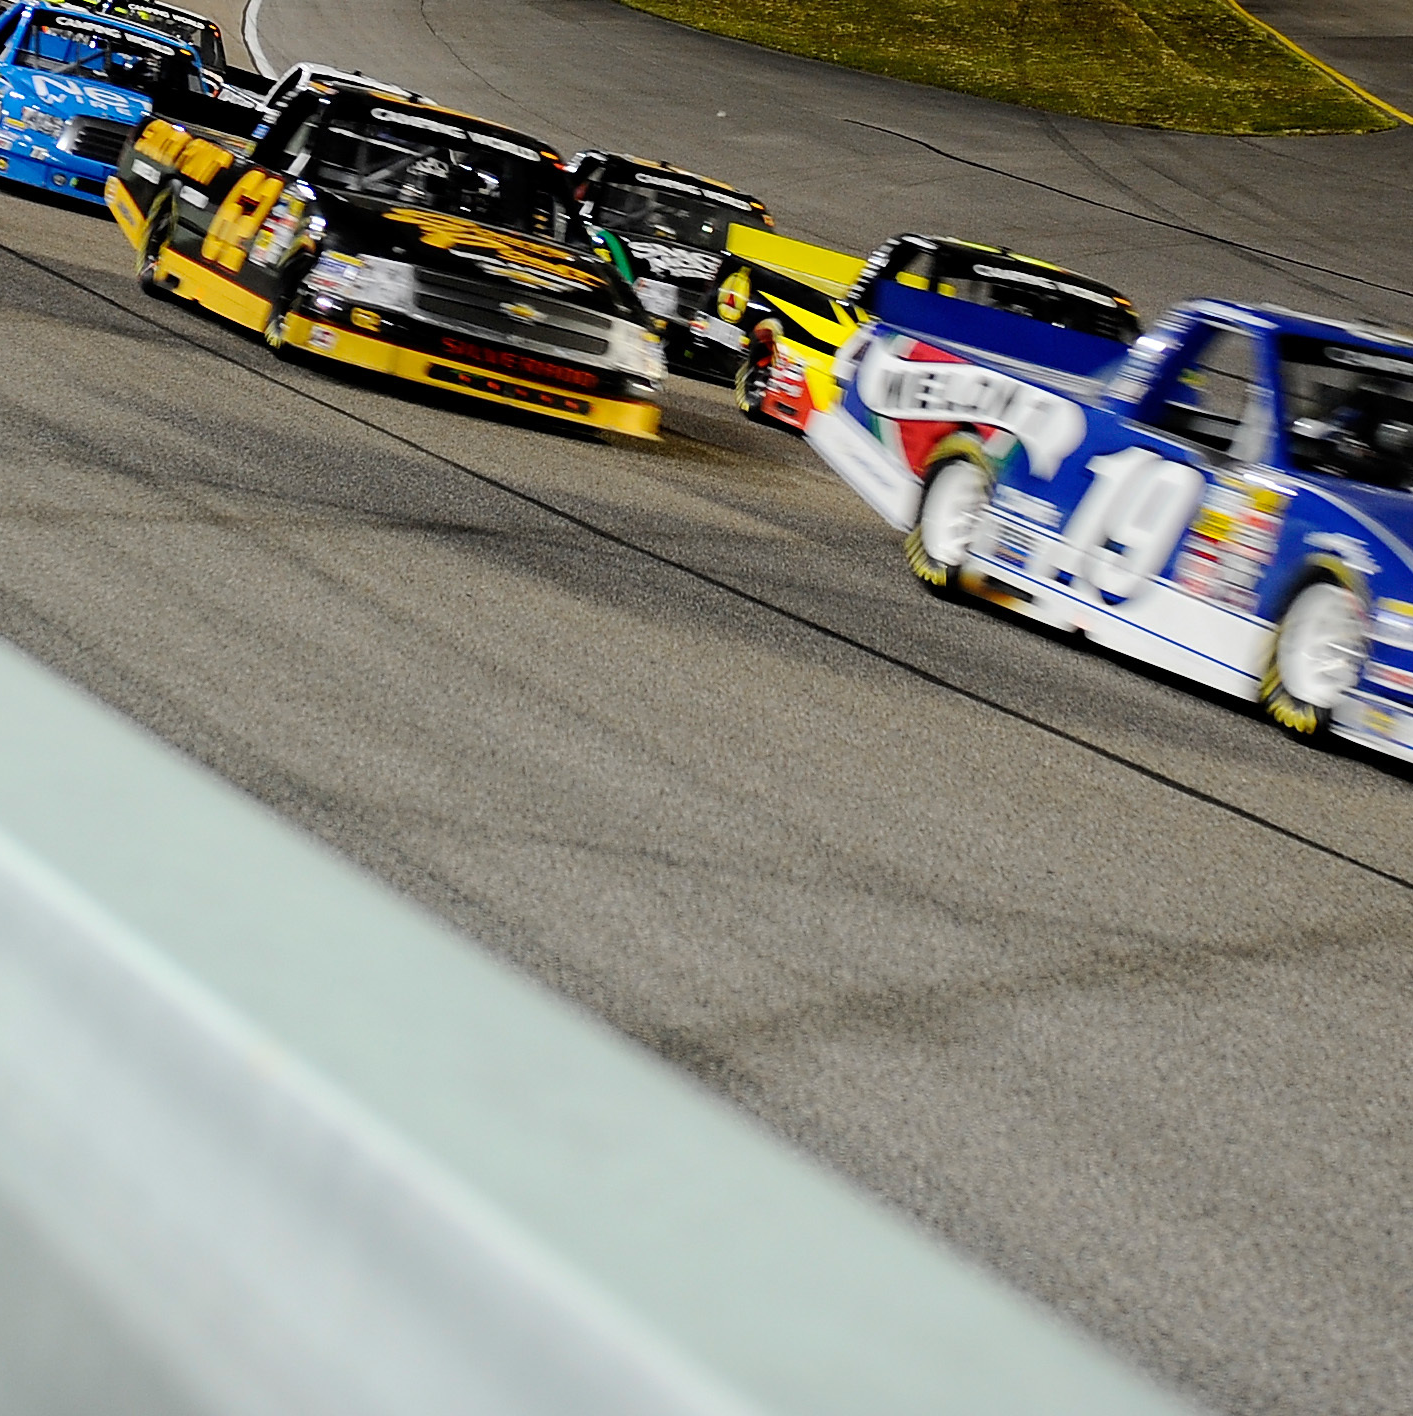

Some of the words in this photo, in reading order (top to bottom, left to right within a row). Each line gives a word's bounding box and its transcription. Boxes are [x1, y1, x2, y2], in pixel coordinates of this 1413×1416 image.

[55, 16, 122, 39] CAMPING
[124, 32, 176, 56] WORLD
[128, 3, 170, 19] CAMPING
[172, 14, 206, 30] WORLD
[371, 107, 467, 140] CAMPING
[467, 130, 542, 162] WORLD
[1046, 446, 1207, 597] 19
